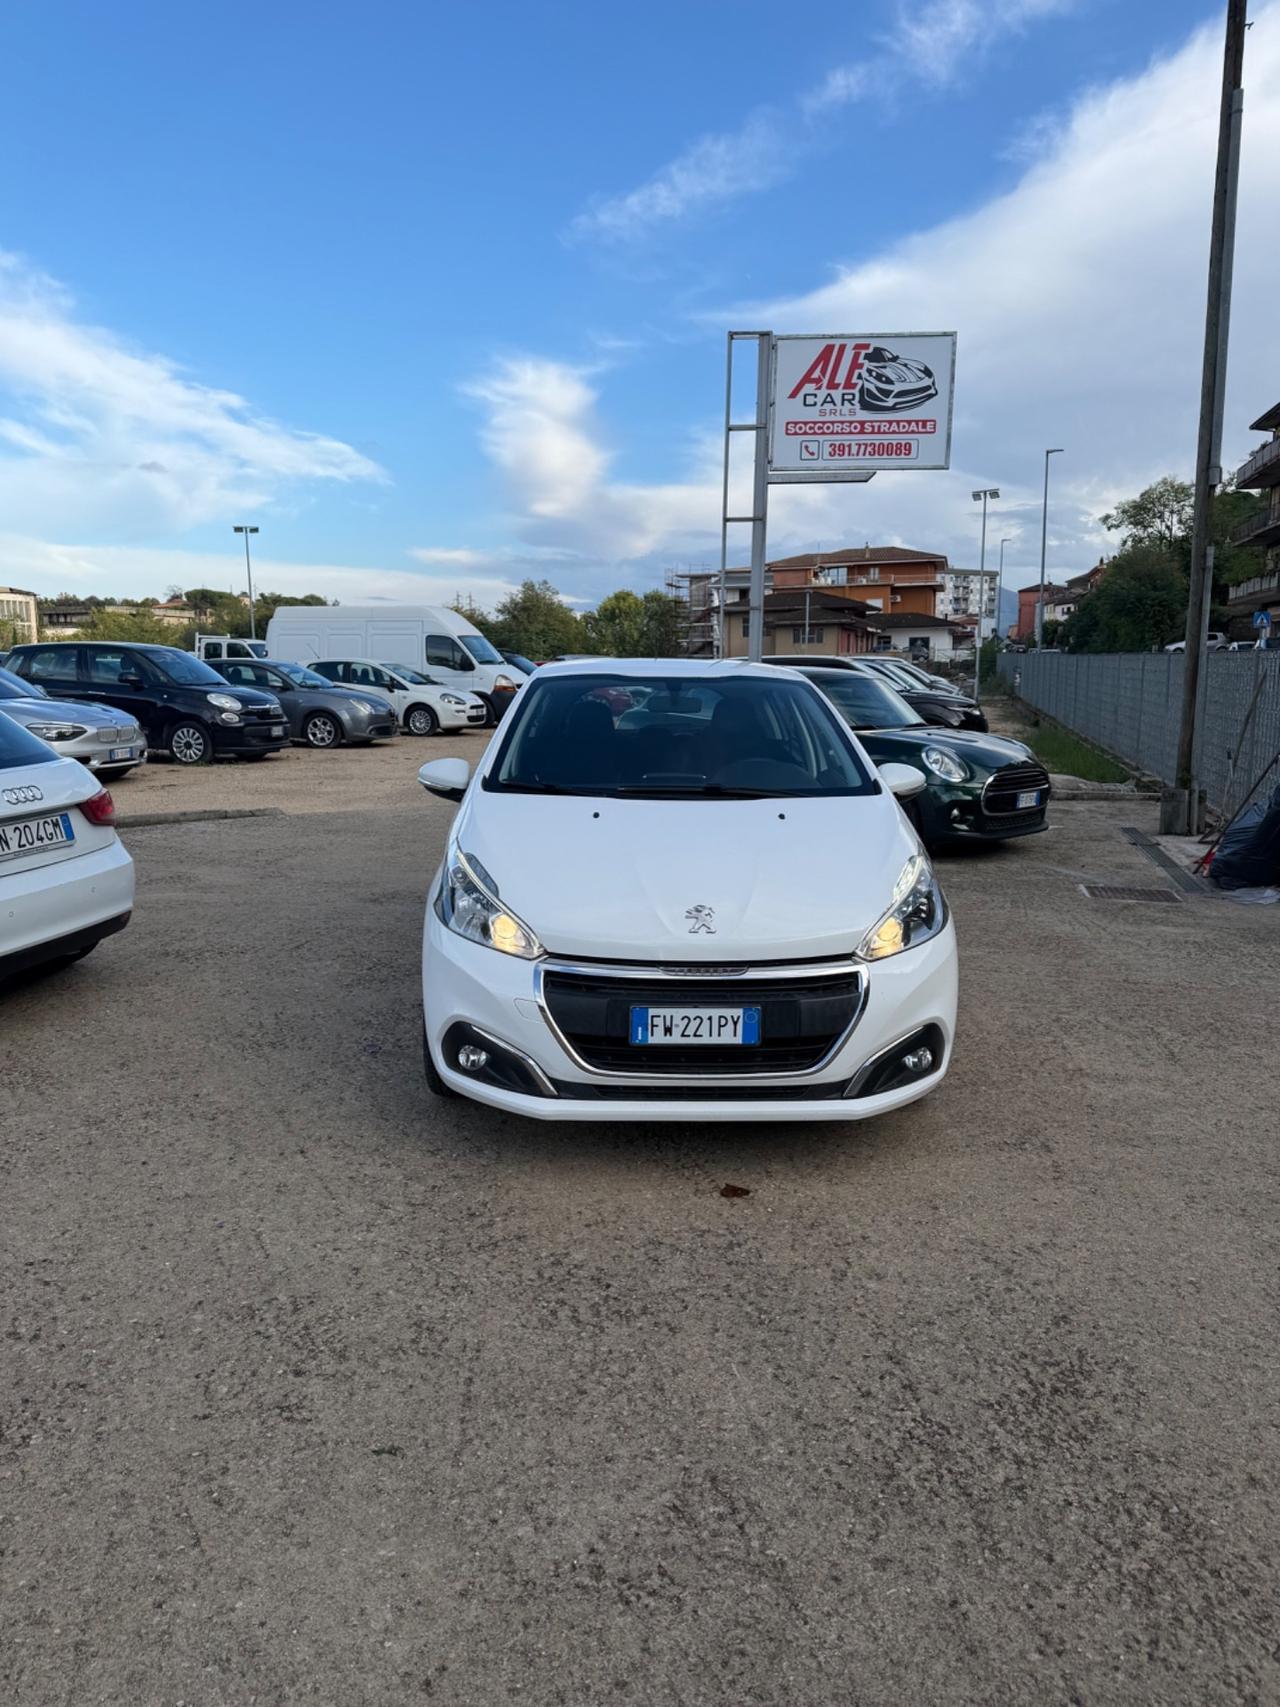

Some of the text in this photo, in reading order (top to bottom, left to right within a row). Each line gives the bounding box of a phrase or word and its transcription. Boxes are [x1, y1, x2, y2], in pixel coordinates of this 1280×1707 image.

[787, 343, 872, 399] ALE
[803, 392, 856, 407] CAR
[818, 408, 857, 417] SRLS
[786, 421, 935, 434] SOCCORSO STRADALE
[828, 442, 912, 457] 391.7730089
